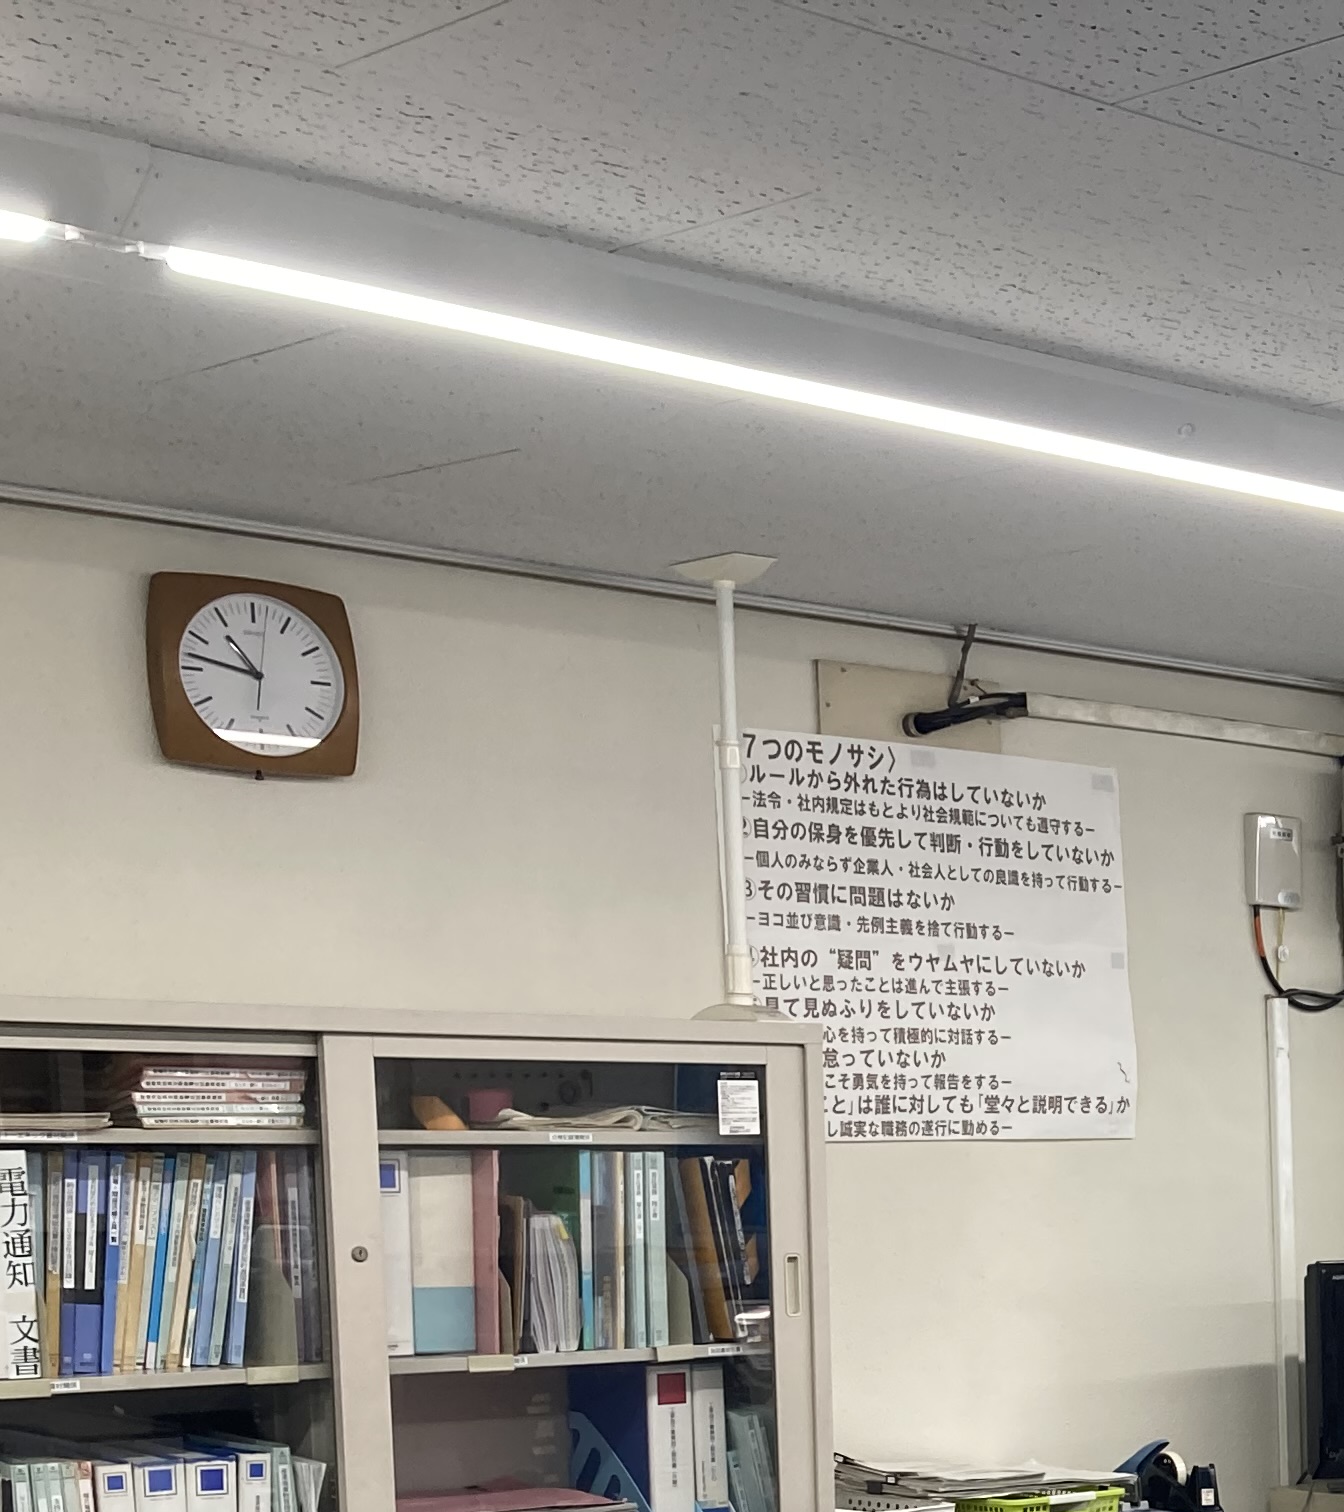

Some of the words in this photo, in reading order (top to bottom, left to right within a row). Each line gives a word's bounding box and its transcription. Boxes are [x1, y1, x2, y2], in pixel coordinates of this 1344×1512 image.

[741, 763, 1047, 811] ルールから外れた行為はしていないか
[754, 996, 995, 1021] 見て見ぬふりをしていないか
[824, 1093, 1130, 1115] と」は誰に対しても「堂々と説明できる」か
[0, 1166, 35, 1289] 電力通知
[9, 1315, 41, 1376] 文書
